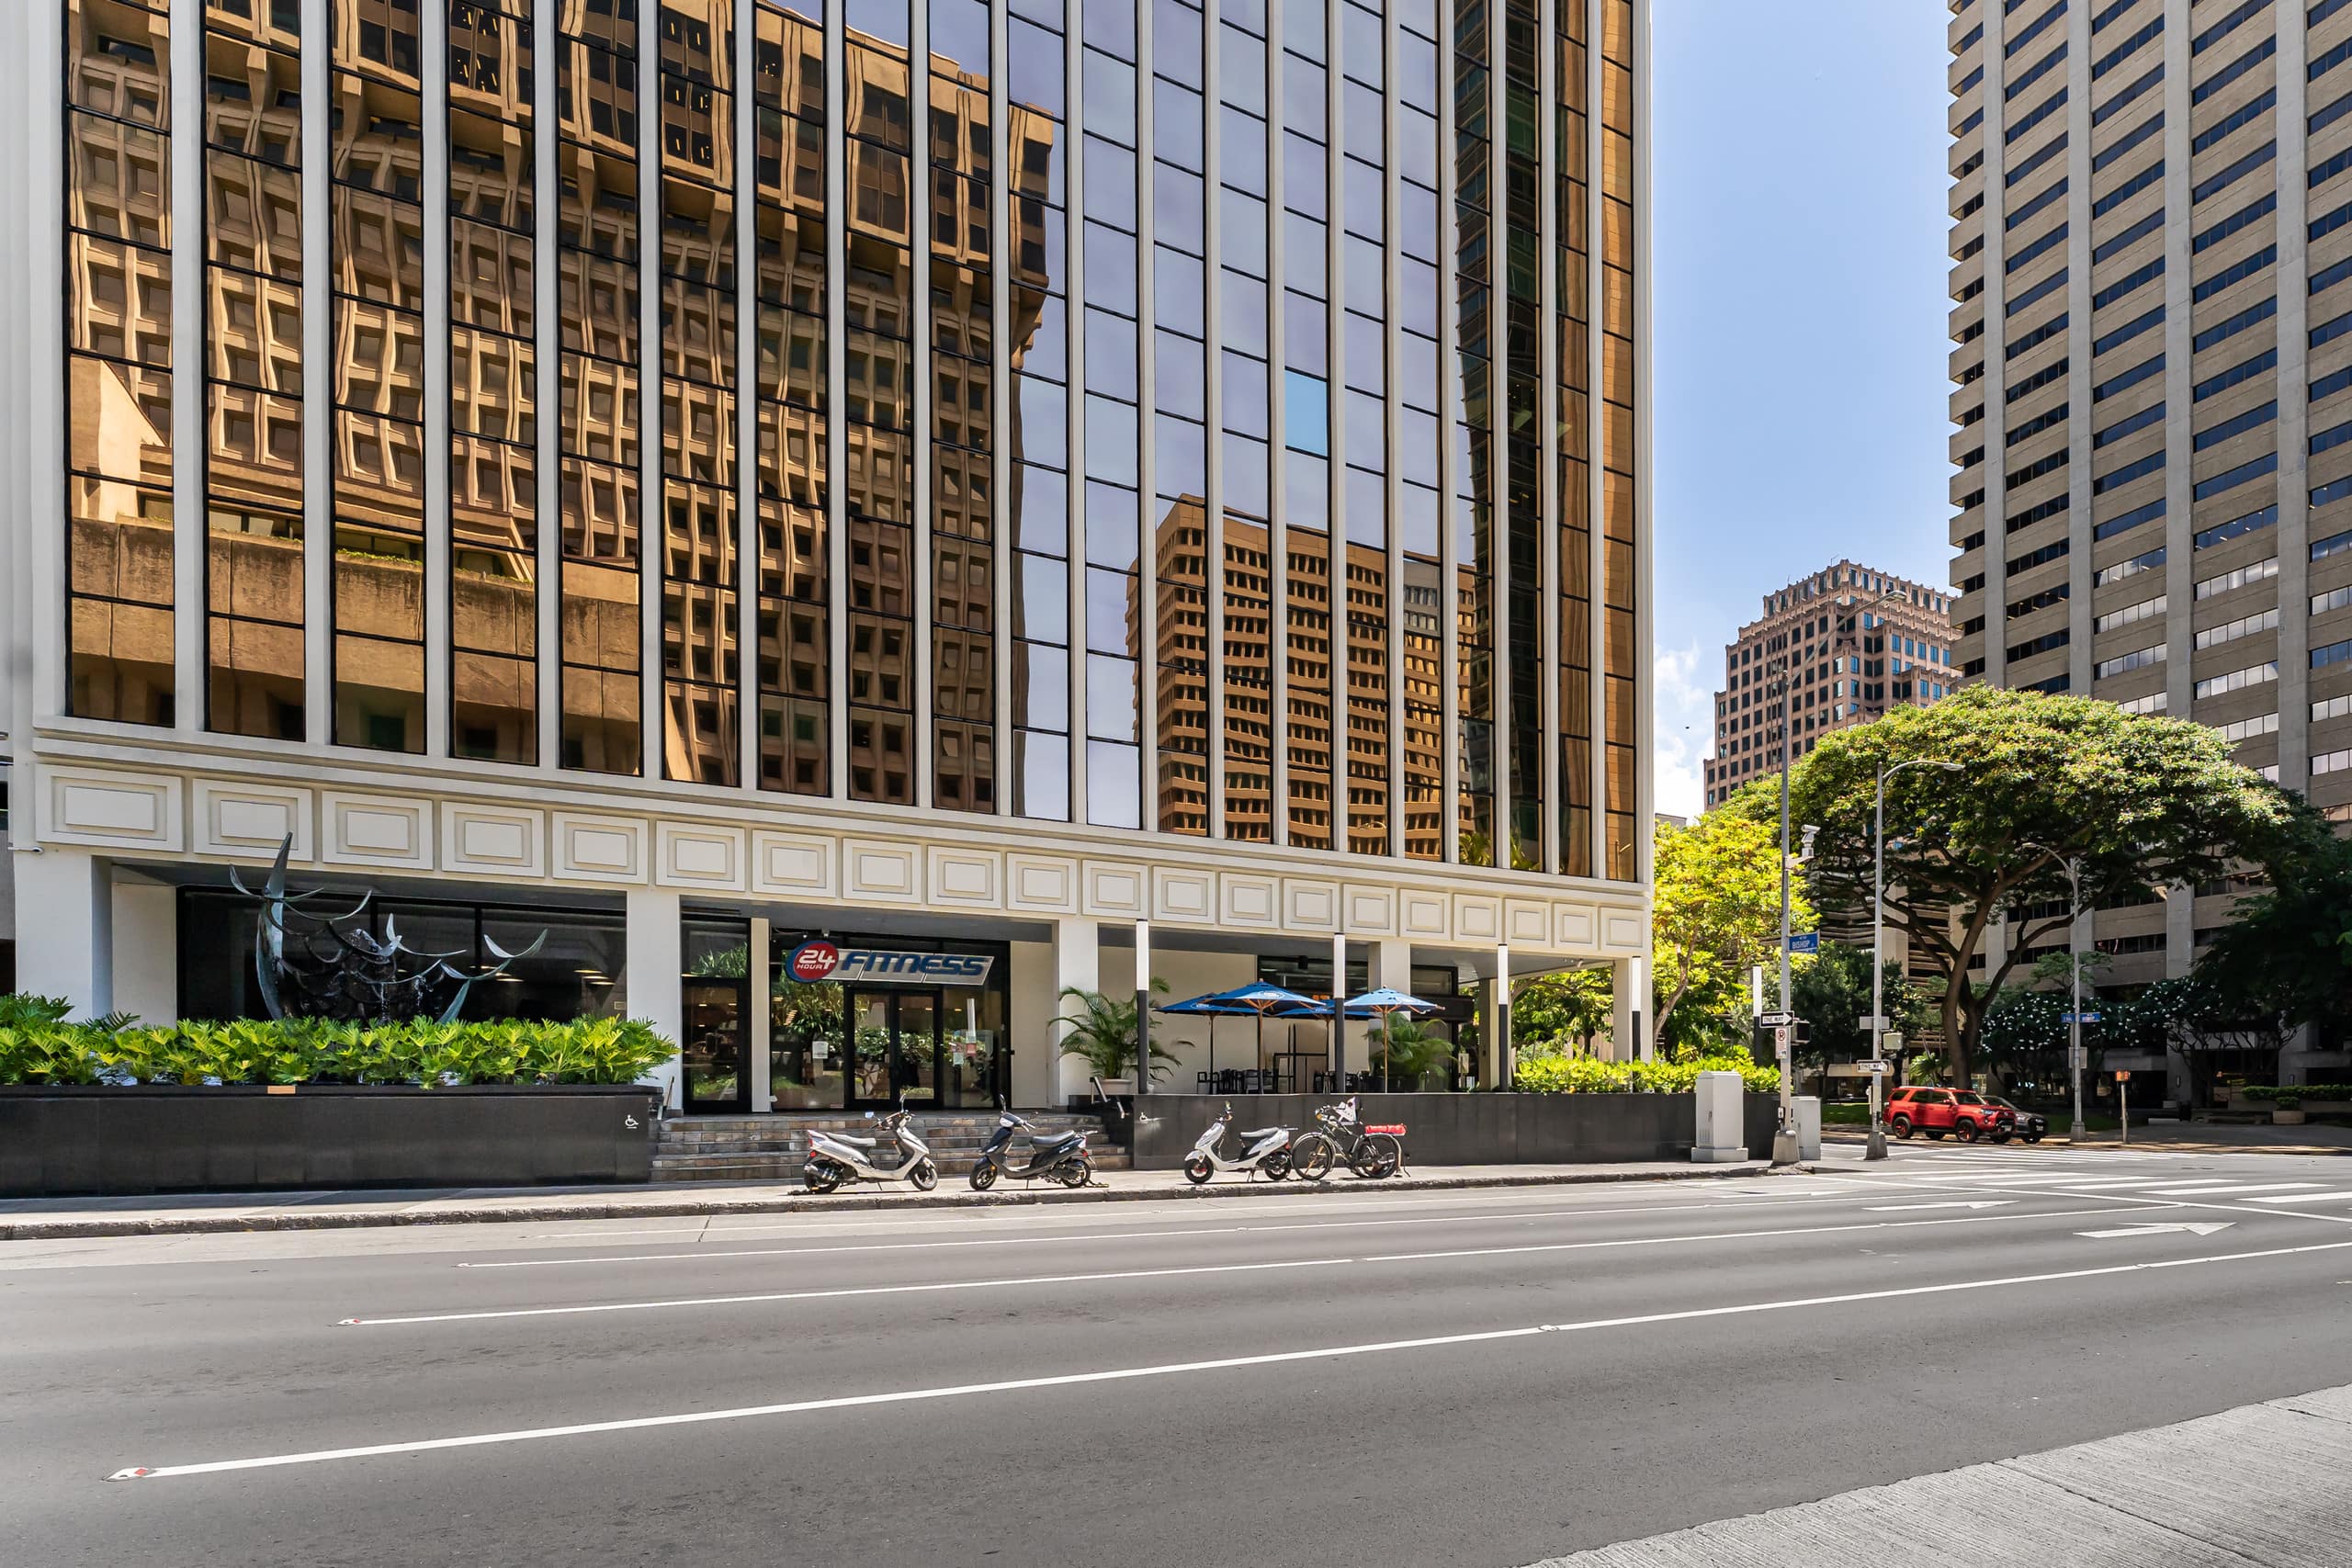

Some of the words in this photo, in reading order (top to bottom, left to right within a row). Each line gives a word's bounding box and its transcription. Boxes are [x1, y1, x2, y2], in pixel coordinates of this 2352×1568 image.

[1792, 940, 1810, 949] BISHOP
[798, 950, 835, 969] 24
[842, 951, 986, 976] FITNESS
